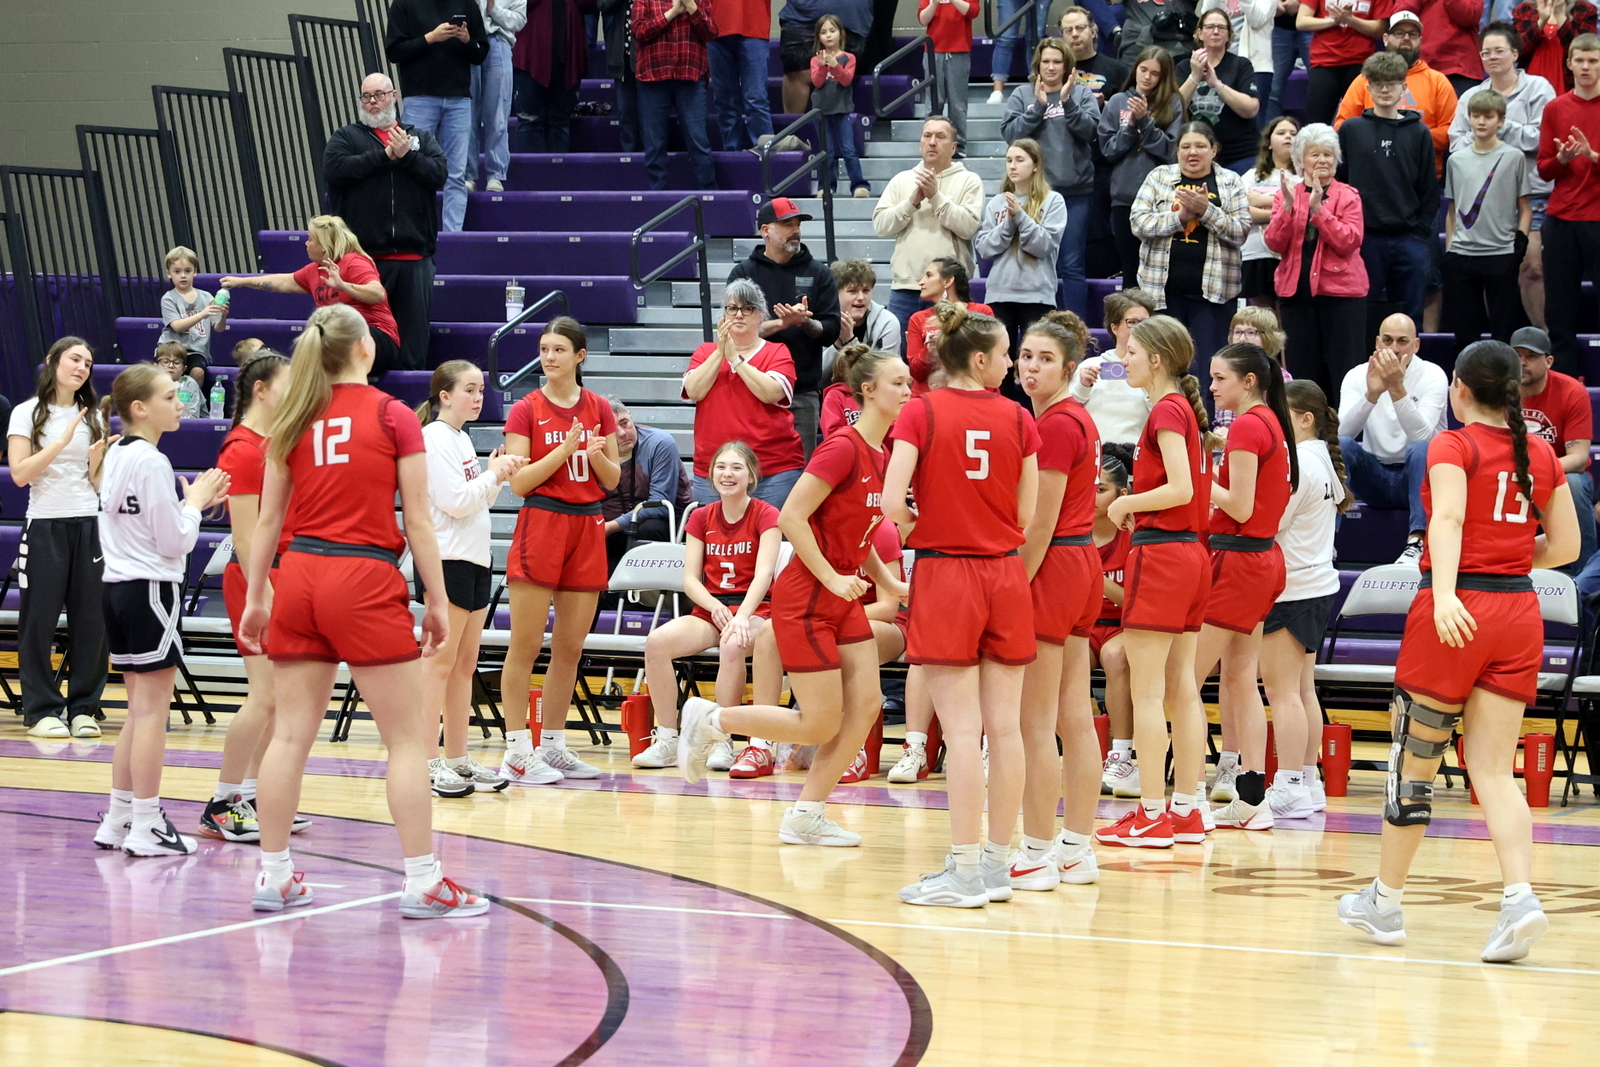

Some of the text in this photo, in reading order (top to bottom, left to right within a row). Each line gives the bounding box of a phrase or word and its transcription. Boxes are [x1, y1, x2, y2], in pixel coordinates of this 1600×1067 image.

[312, 416, 352, 467] 12
[965, 429, 991, 480] 5
[1493, 471, 1534, 523] 13
[624, 558, 686, 568] BLUFFTO
[719, 562, 736, 589] 2
[1534, 586, 1566, 596] TON
[1098, 861, 1600, 899] COPE
